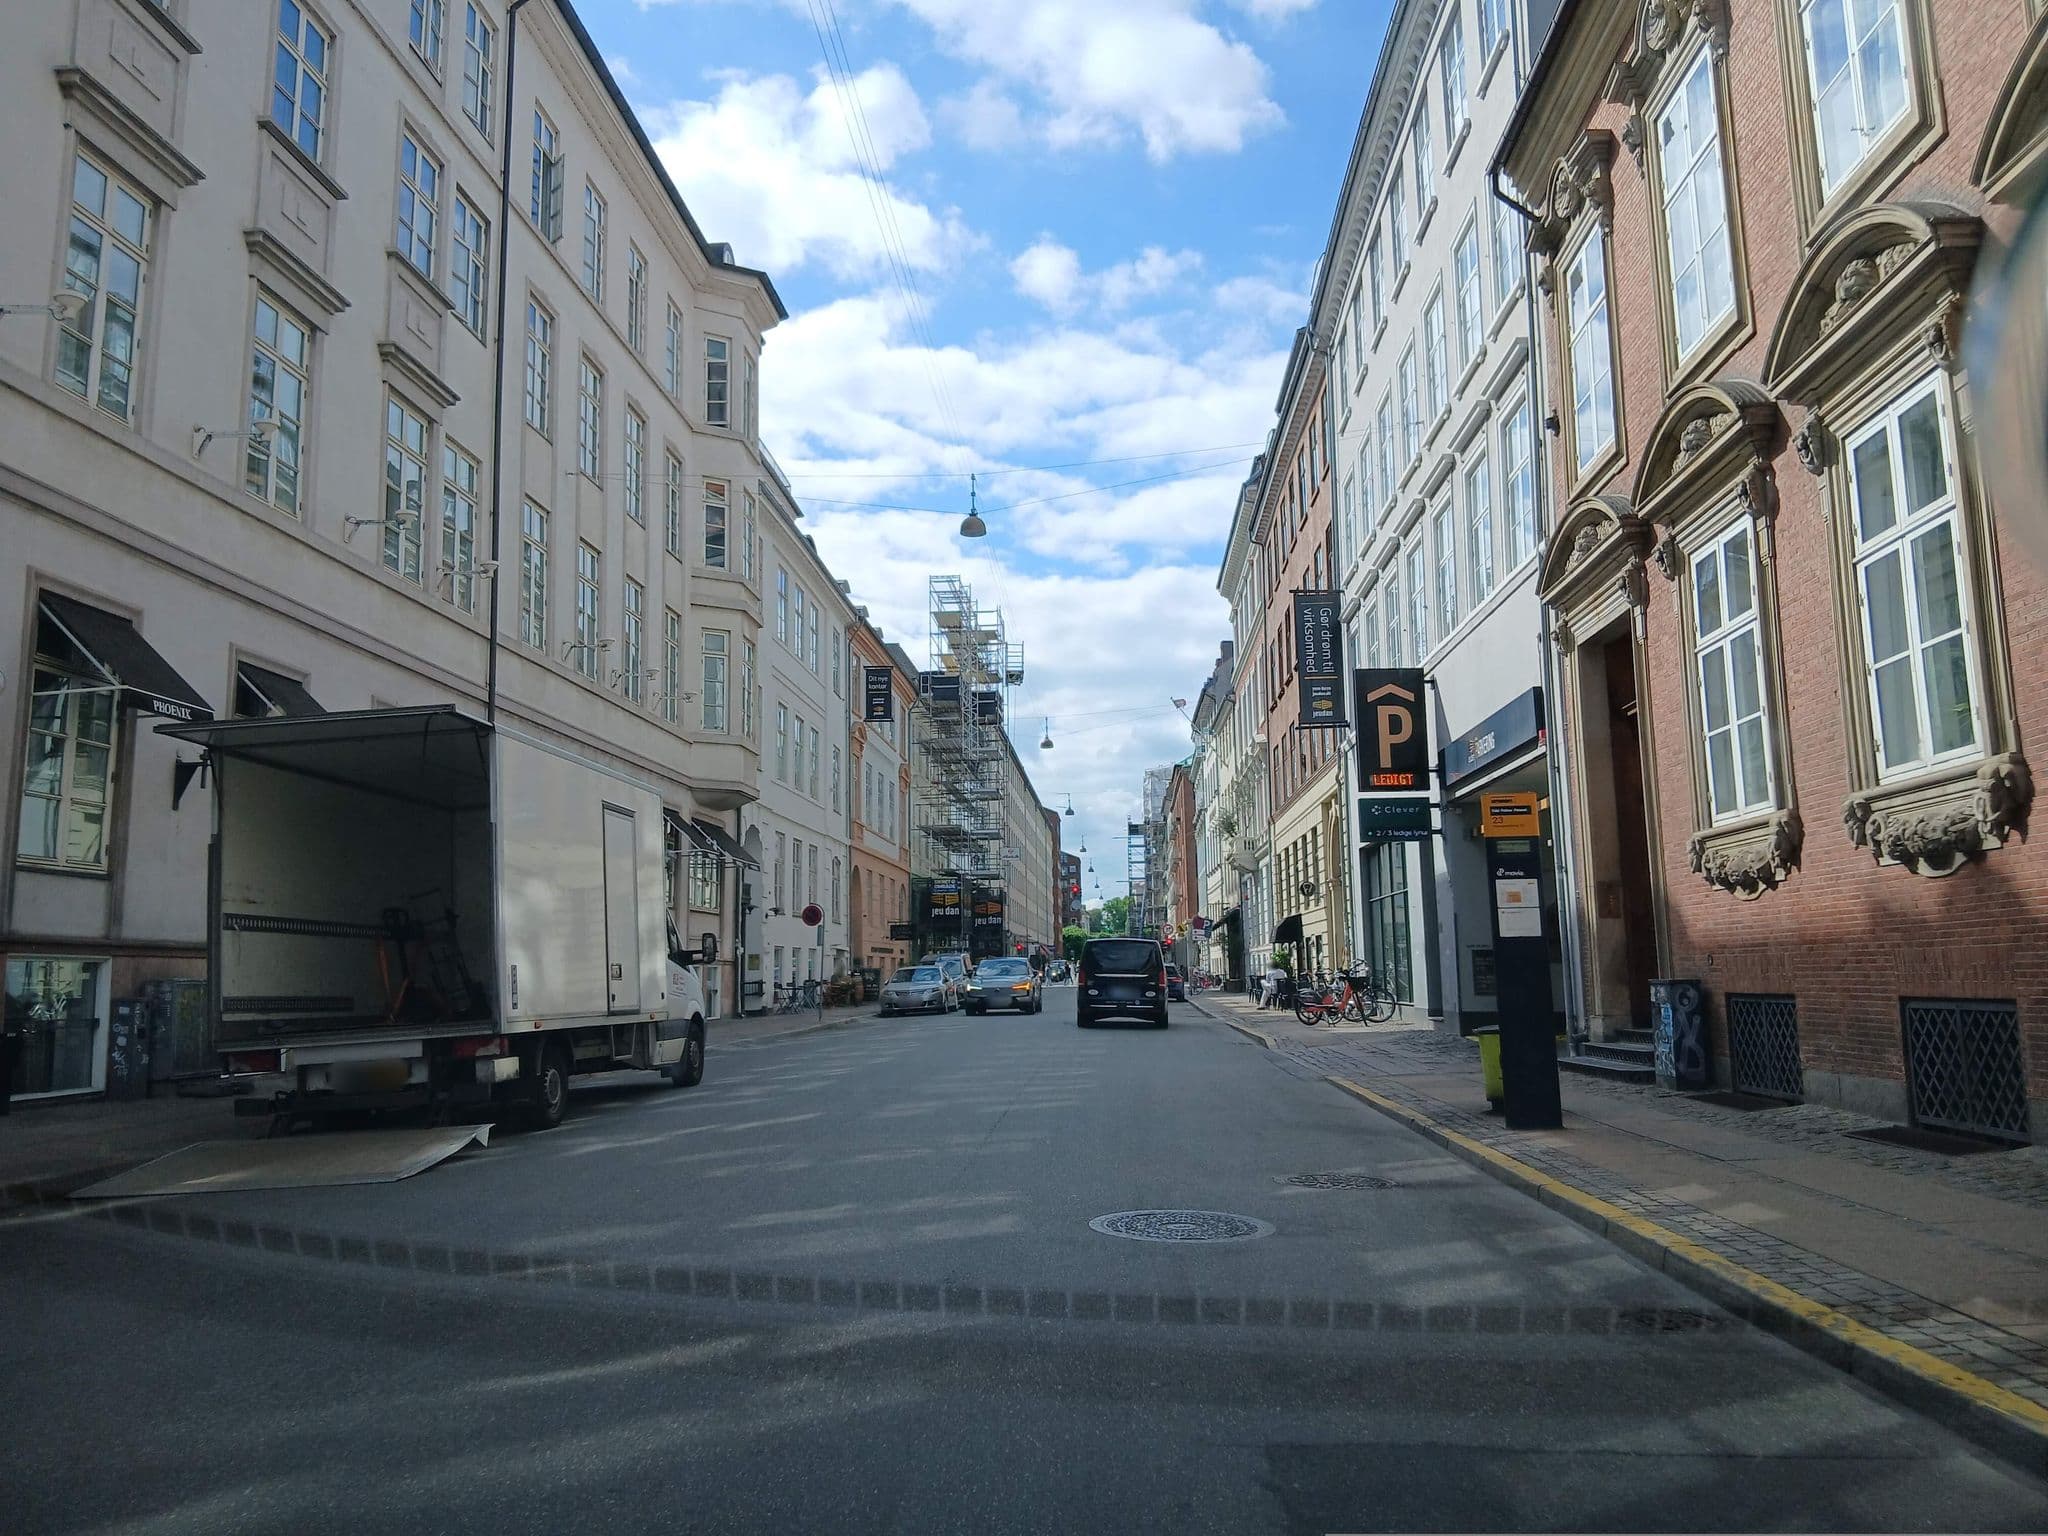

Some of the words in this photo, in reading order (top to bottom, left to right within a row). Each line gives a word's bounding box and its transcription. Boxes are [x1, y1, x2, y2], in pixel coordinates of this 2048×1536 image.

[1320, 607, 1332, 629] Gør
[1303, 607, 1318, 673] virksomhed
[1321, 630, 1334, 660] drøm
[1322, 661, 1335, 673] til
[152, 699, 193, 720] PHOENIX
[1376, 705, 1413, 769] P
[1372, 773, 1415, 786] LEDIGT
[1384, 806, 1420, 814] Clever
[1491, 816, 1504, 824] 23
